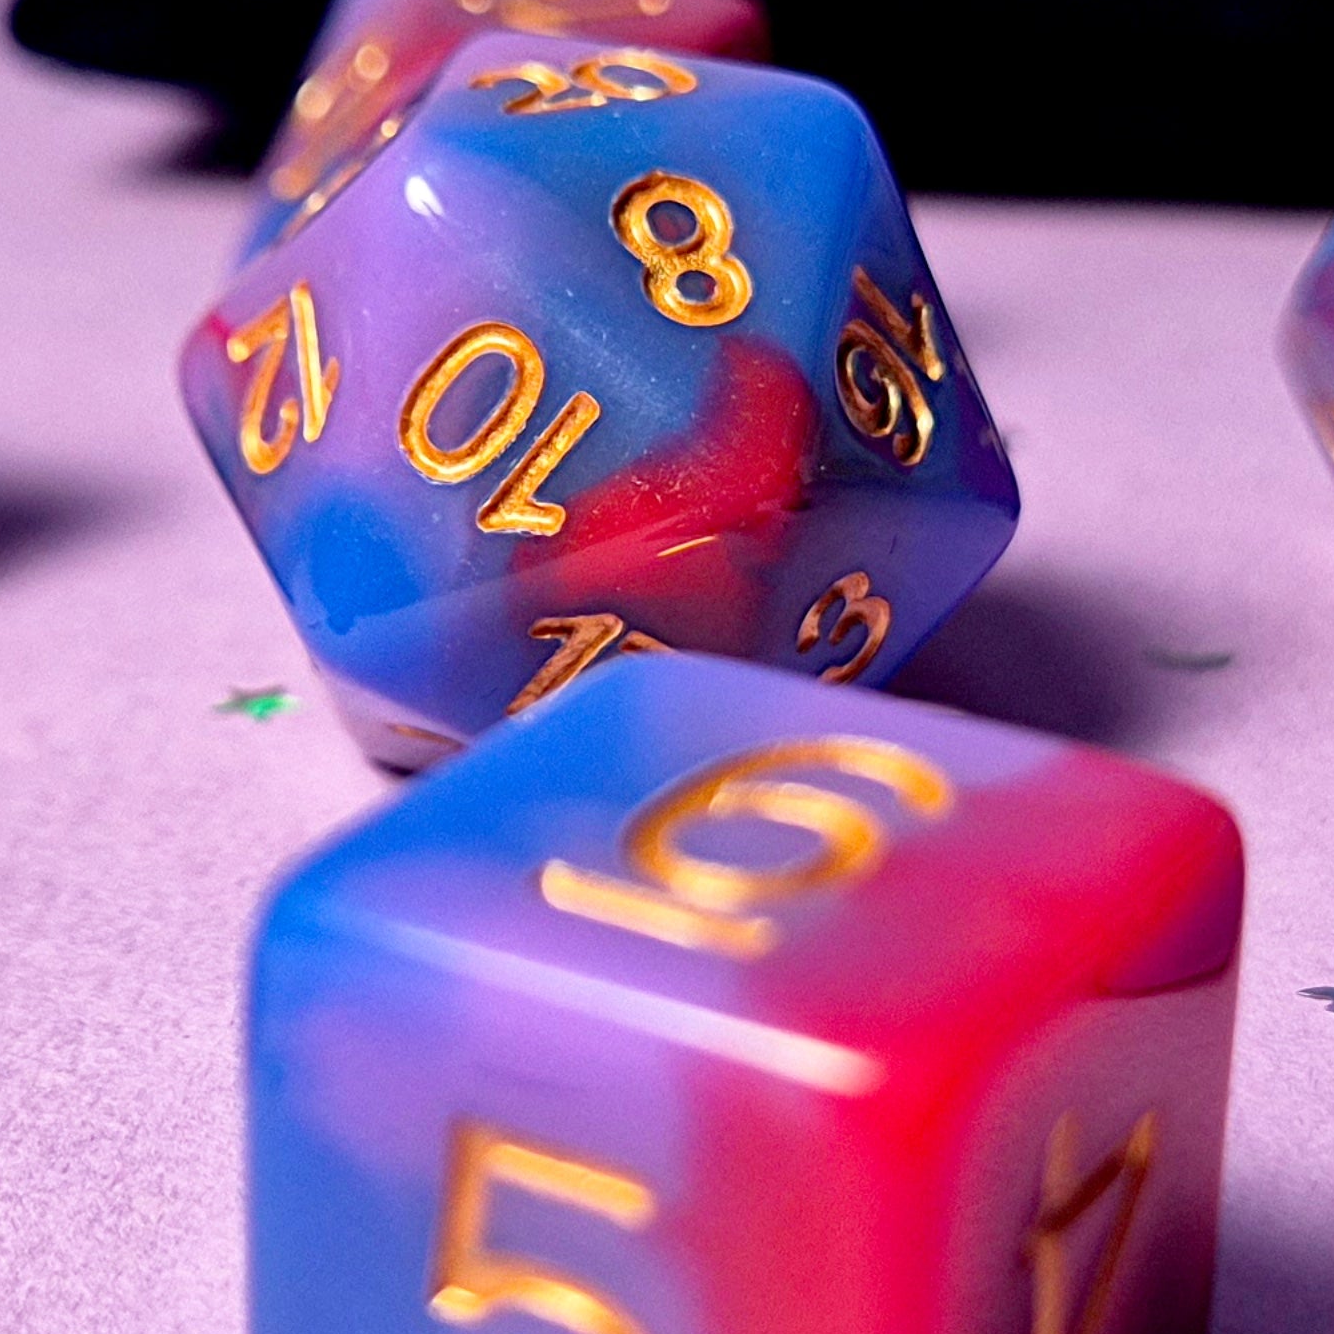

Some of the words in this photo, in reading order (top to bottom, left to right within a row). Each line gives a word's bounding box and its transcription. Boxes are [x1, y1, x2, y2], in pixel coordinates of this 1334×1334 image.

[470, 49, 698, 115] 20
[609, 170, 752, 327] 8
[227, 279, 340, 475] 12
[398, 321, 600, 535] 10
[836, 264, 944, 465] 16
[796, 571, 891, 685] 3
[539, 735, 958, 960] 6
